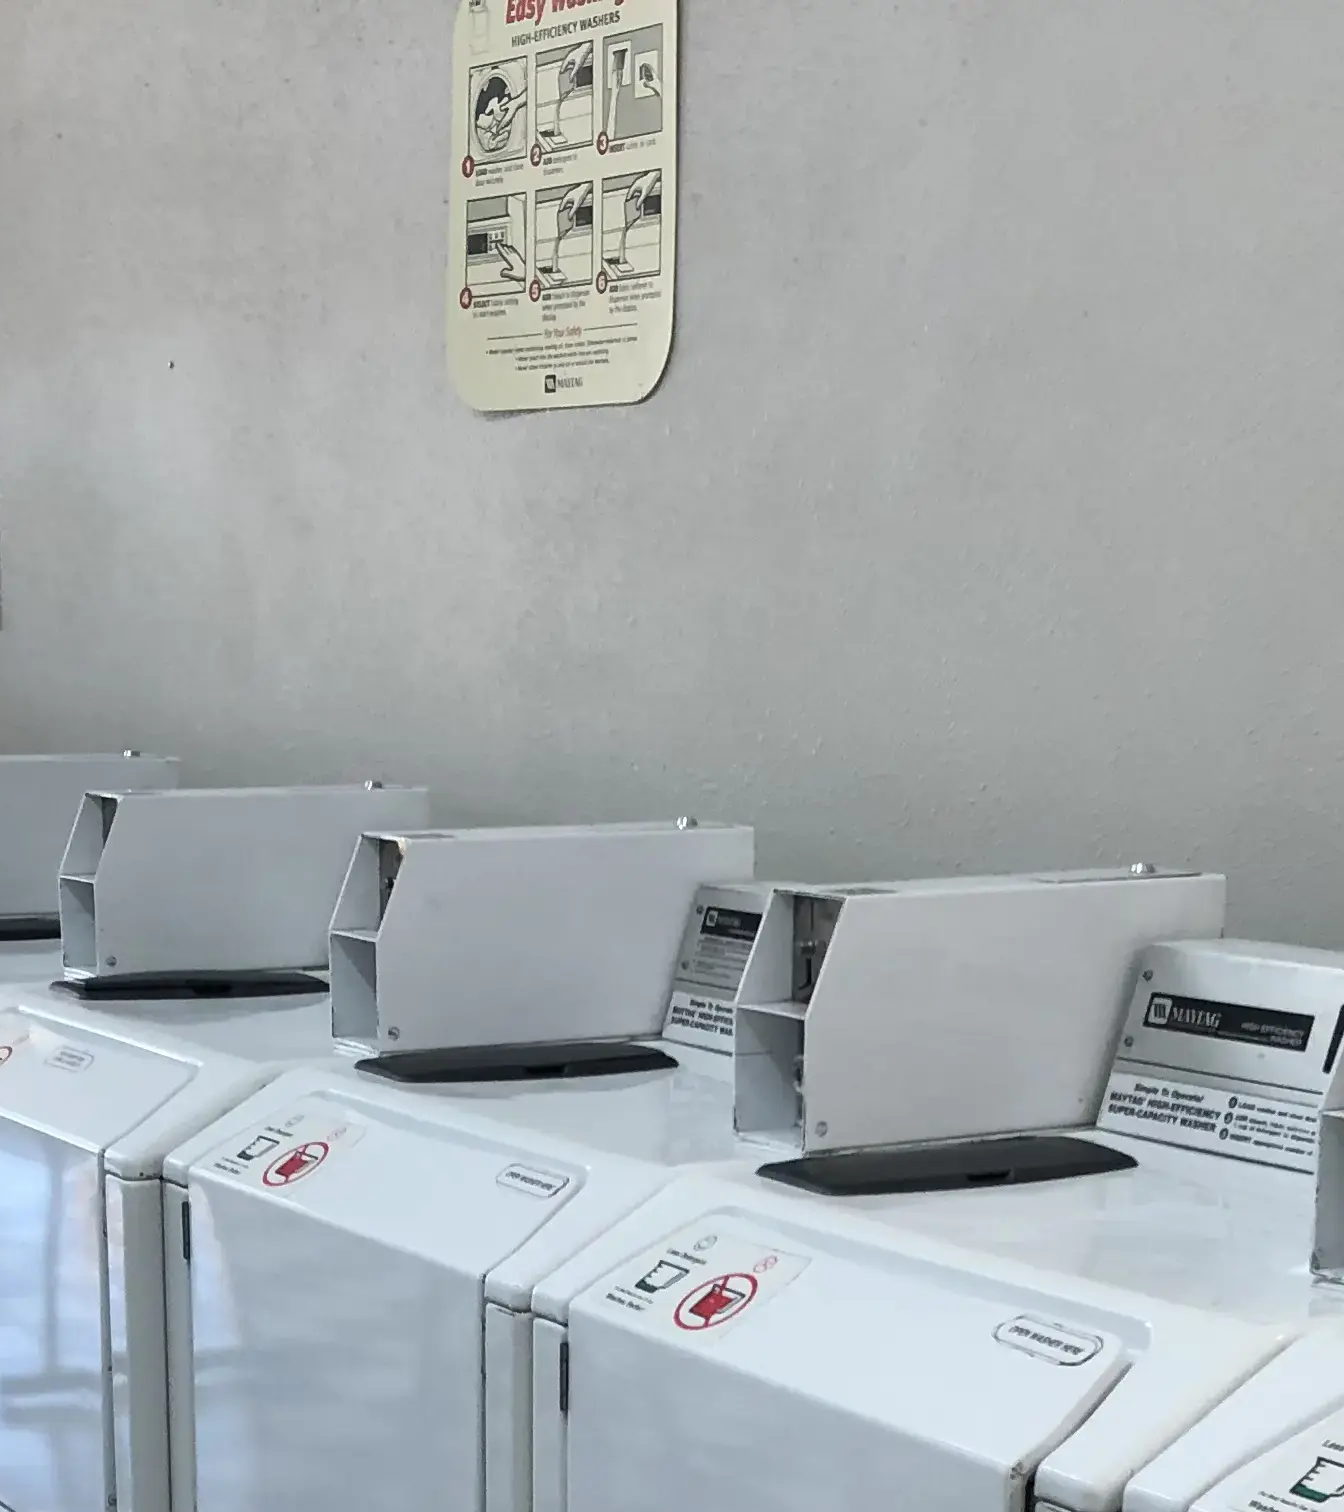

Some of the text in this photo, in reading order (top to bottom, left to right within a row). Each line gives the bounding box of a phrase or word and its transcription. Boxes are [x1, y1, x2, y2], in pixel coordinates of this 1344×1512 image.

[511, 10, 621, 47] HIGH-EFFICIENCY WASHERS
[1172, 1006, 1222, 1029] MAYTAG
